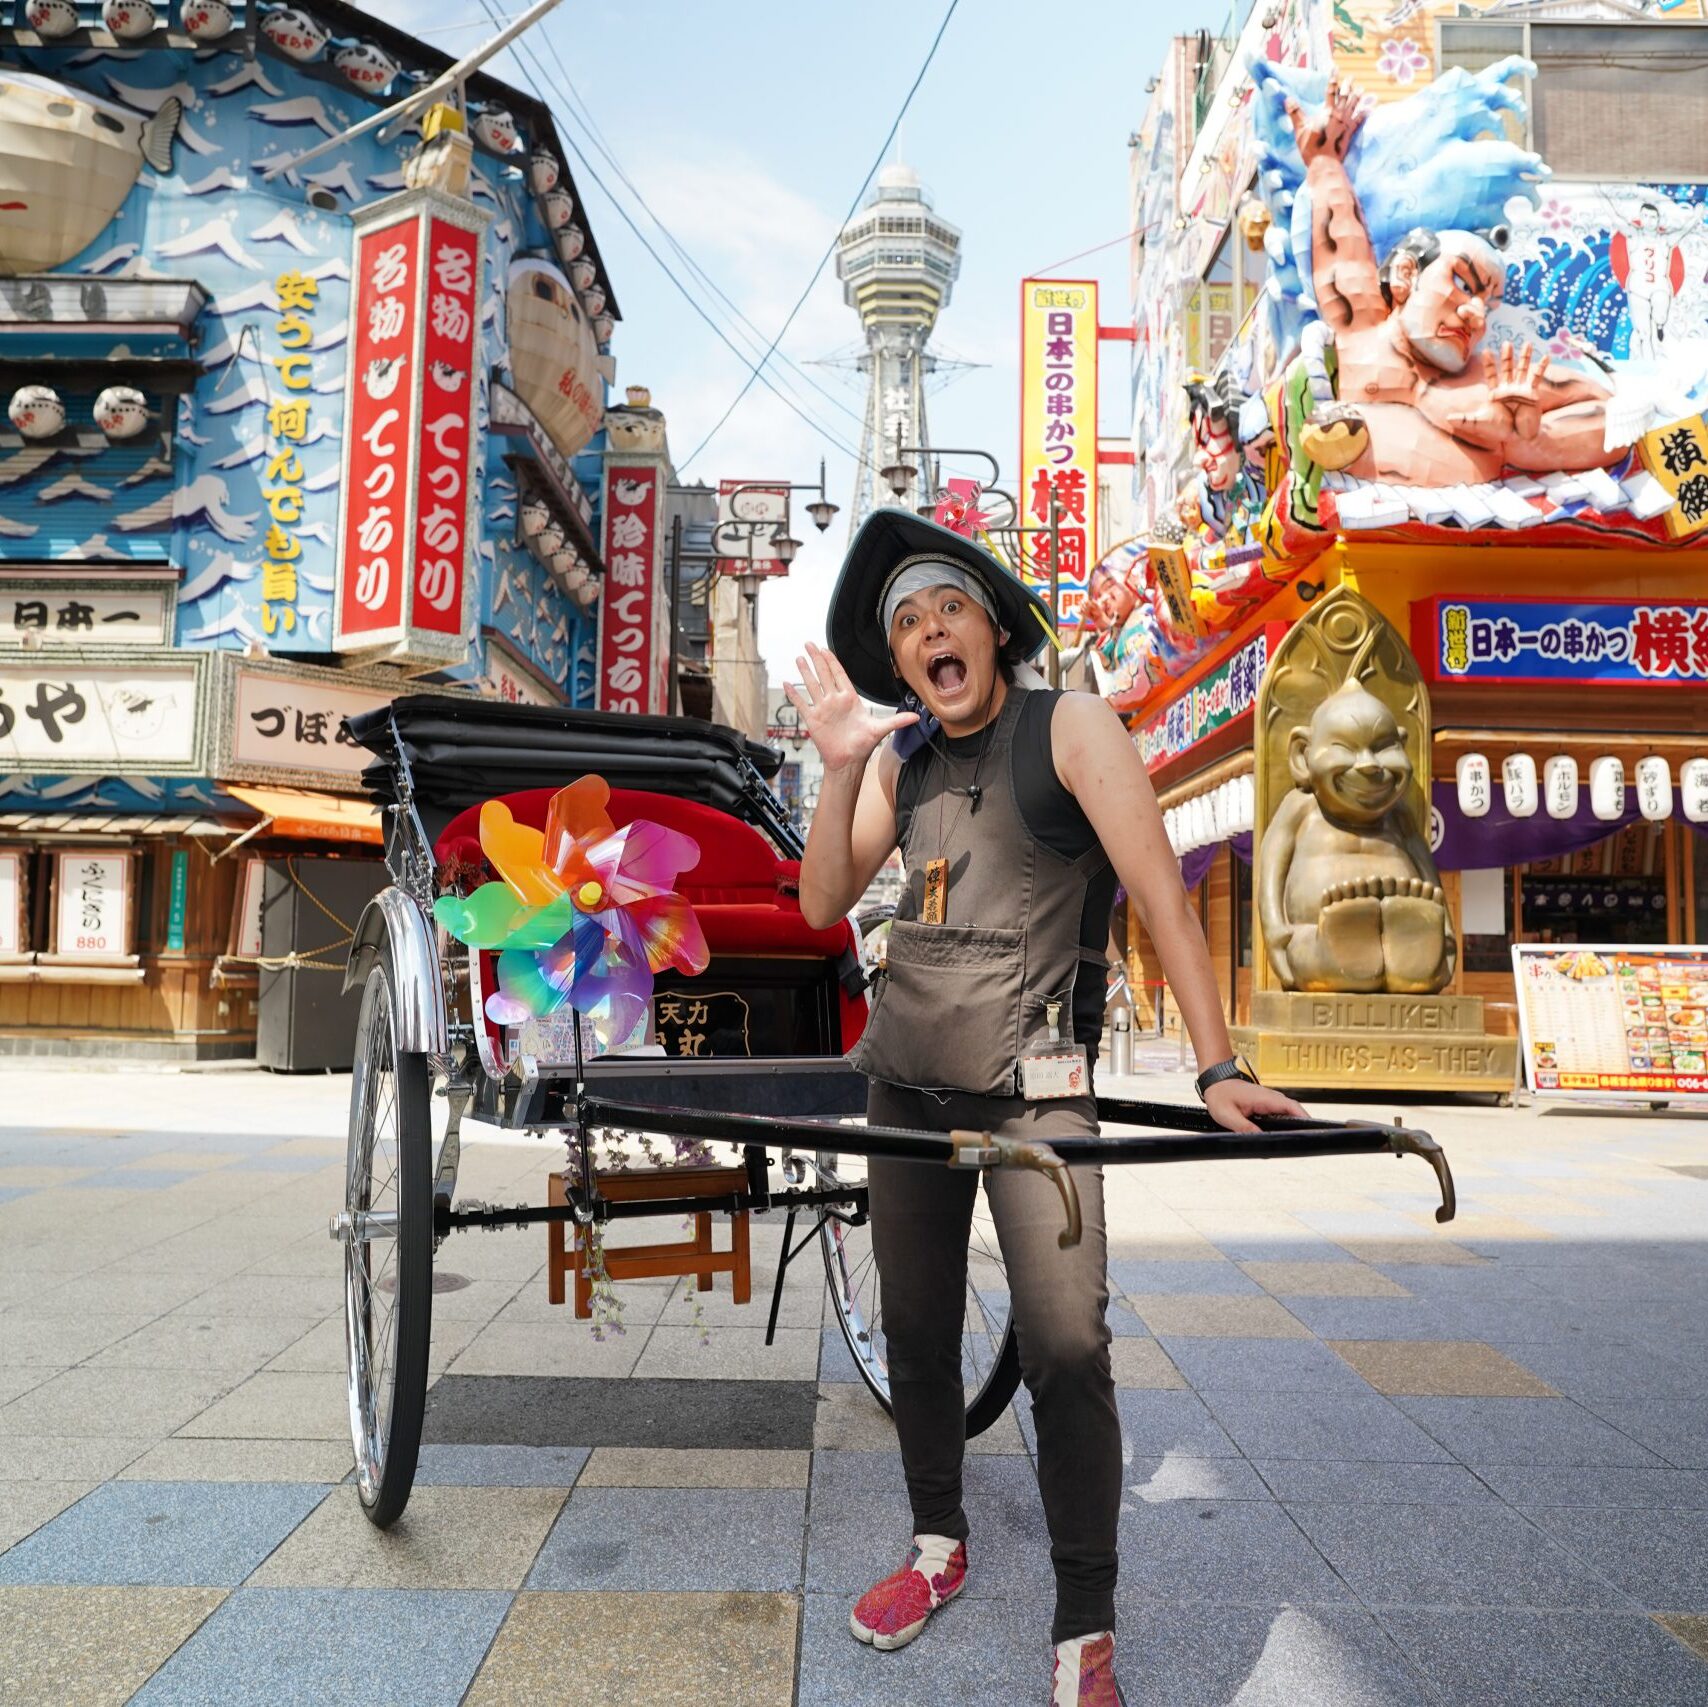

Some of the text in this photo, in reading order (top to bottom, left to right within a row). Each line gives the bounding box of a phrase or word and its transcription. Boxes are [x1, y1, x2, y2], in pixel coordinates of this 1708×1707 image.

[367, 244, 407, 344] 名物
[431, 244, 473, 344] 名物
[1045, 312, 1074, 464] 日本一の串かつ
[260, 270, 319, 637] 安うて何んでも旨い
[1031, 469, 1087, 583] 横綱
[14, 602, 140, 631] 日本一
[1472, 622, 1628, 658] 日本一の串かつ
[1470, 771, 1484, 809] 串かつ
[76, 937, 106, 949] 880
[659, 1001, 708, 1025] 天力
[1313, 1002, 1459, 1031] BILLIKEN
[1281, 1044, 1495, 1073] THINGS-AS-THEY
